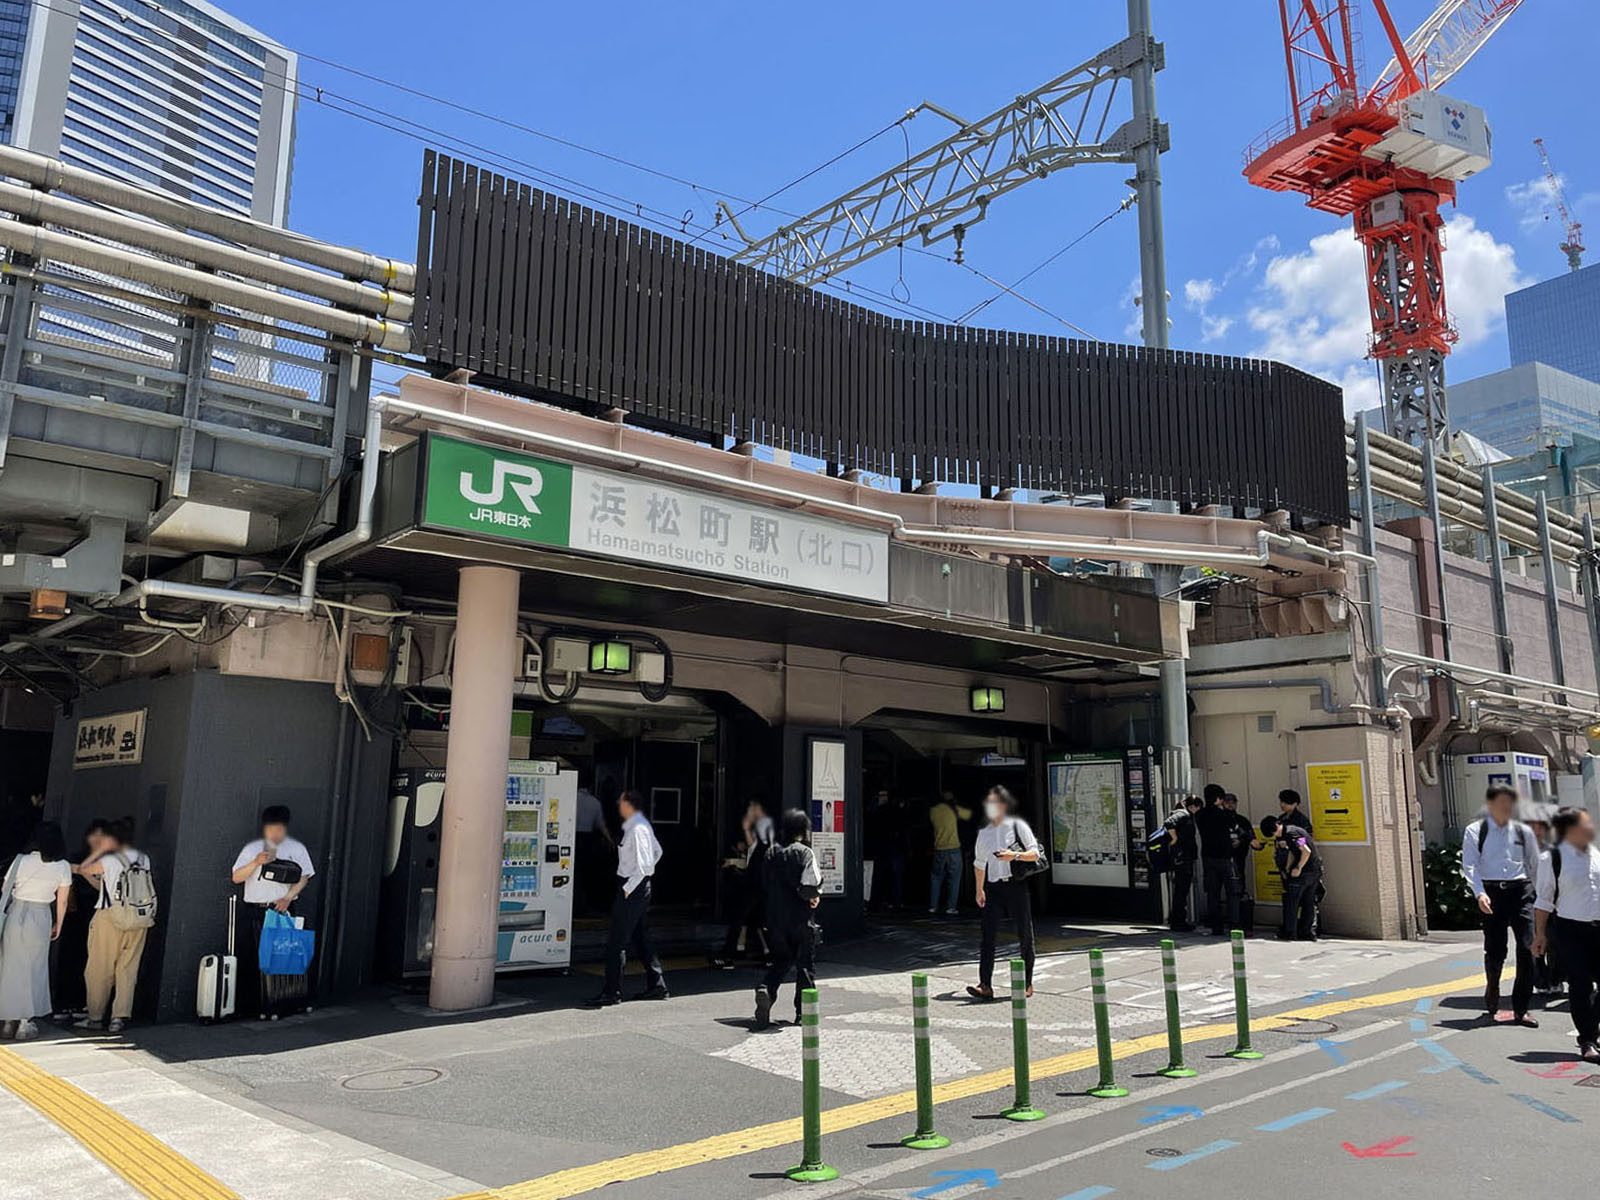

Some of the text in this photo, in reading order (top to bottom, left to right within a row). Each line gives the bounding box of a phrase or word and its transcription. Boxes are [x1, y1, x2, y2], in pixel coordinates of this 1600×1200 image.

[460, 459, 543, 515] JR
[469, 507, 532, 529] JR東日本
[588, 528, 789, 580] Hamamatsuchō Station
[519, 932, 553, 944] acure
